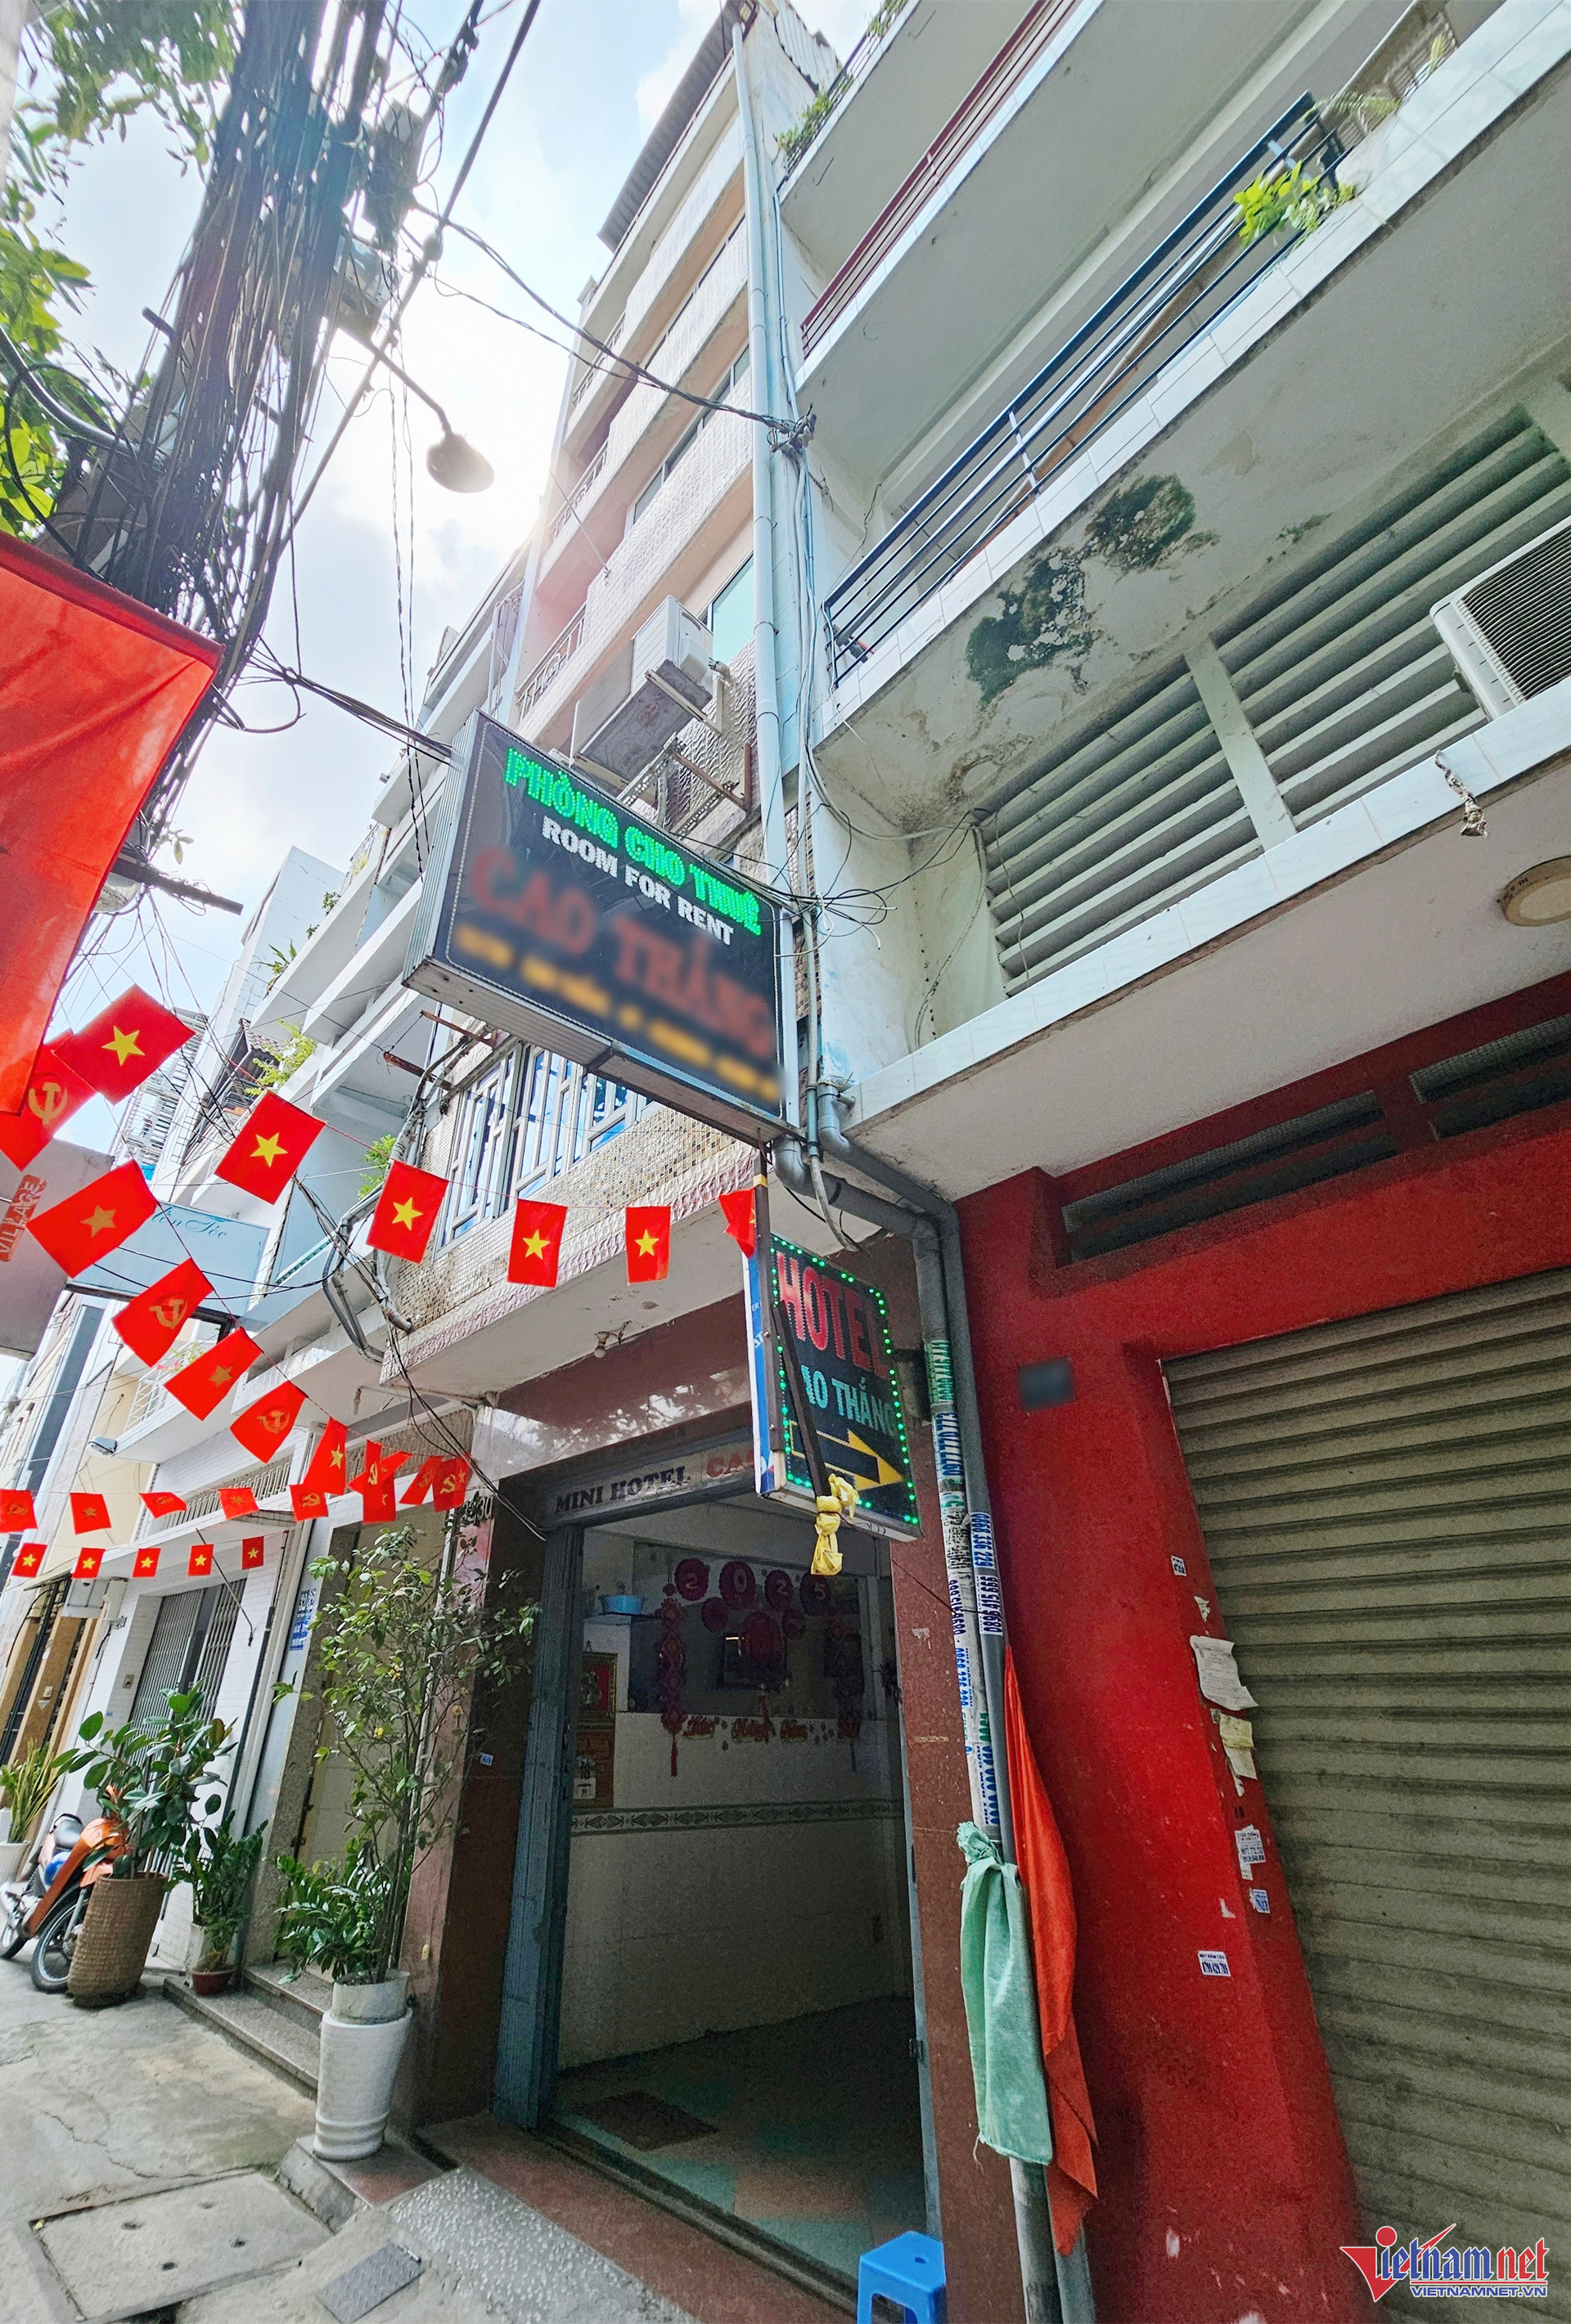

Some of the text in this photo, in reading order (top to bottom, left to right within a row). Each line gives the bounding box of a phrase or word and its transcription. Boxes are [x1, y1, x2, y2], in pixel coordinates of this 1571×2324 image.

[505, 748, 619, 848] PHÒNG
[624, 825, 686, 886] CHO
[542, 815, 734, 946] ROOM FOR RENT
[0, 1180, 40, 1253] VILLAGE
[776, 1251, 891, 1379] HOTEL
[555, 1485, 604, 1513] MINI
[609, 1465, 691, 1502] HOTEL
